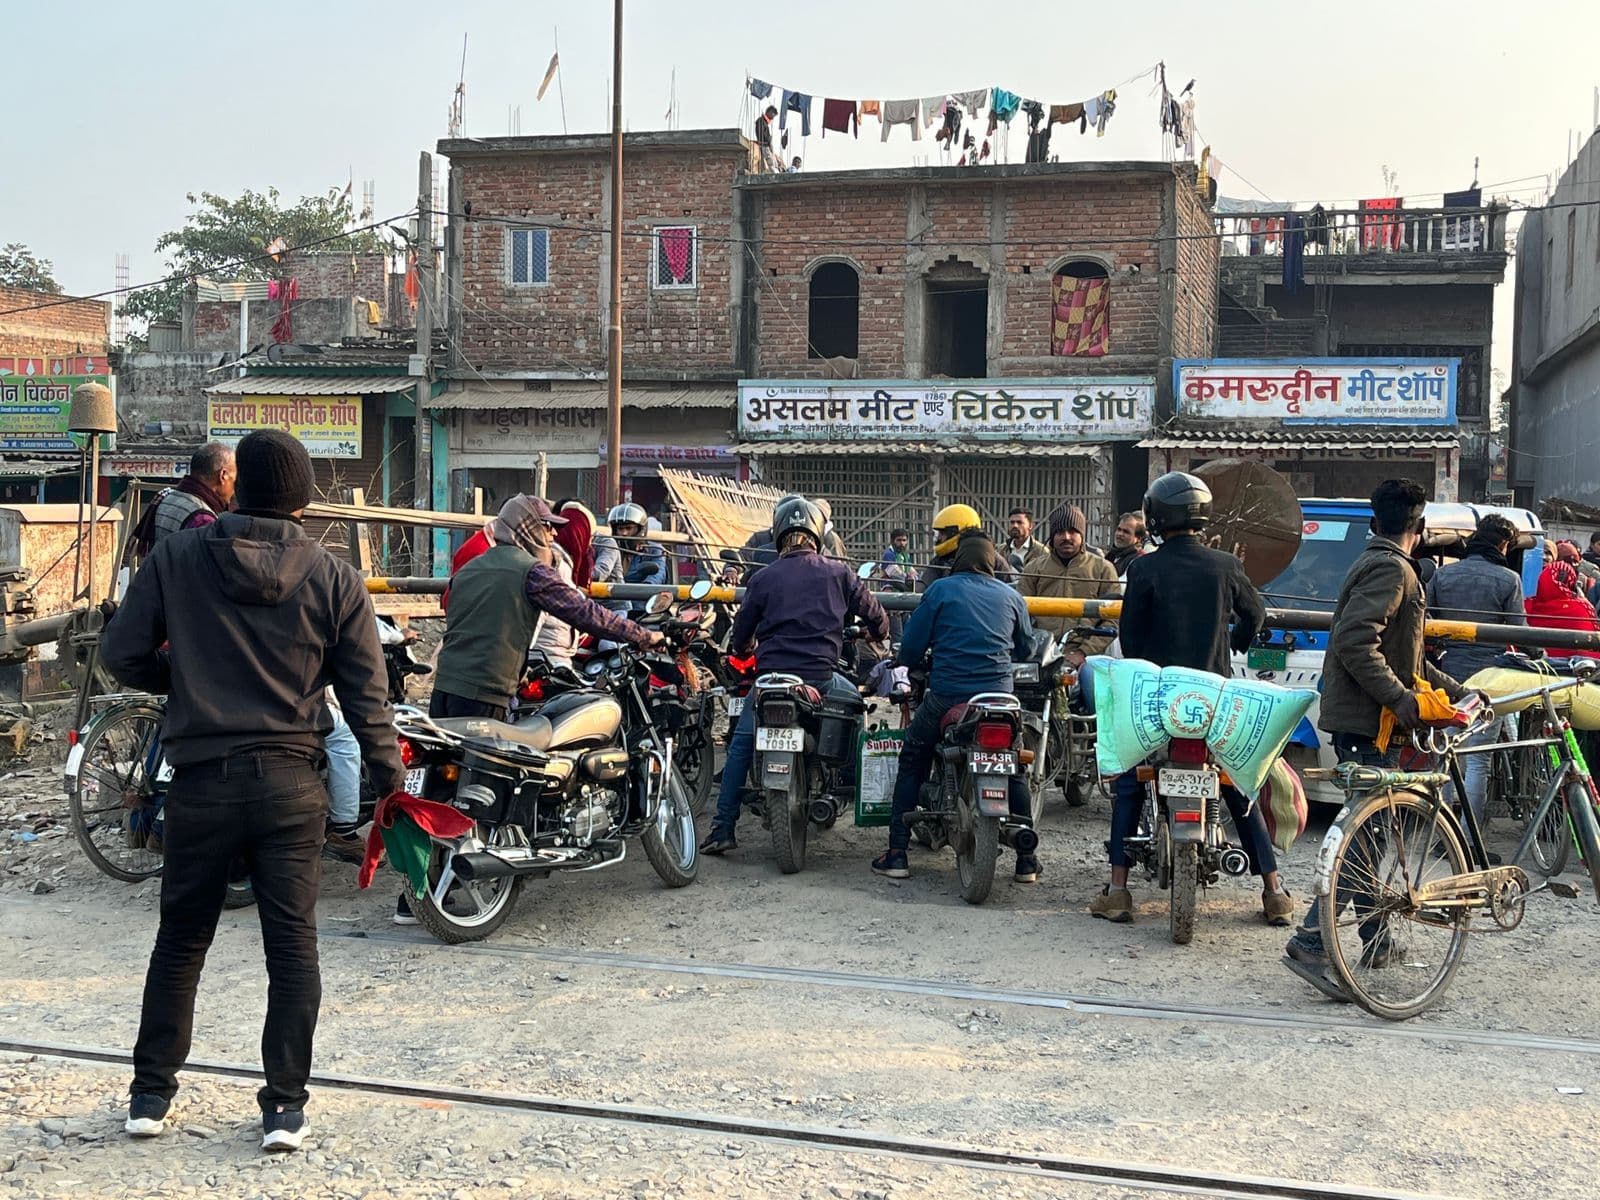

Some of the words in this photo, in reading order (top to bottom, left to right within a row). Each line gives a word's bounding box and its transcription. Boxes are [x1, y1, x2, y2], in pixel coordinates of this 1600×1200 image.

[23, 378, 70, 402] चिकेन
[1348, 369, 1395, 401] मीट
[1397, 372, 1445, 401] शॉप
[746, 398, 852, 421] असलम
[857, 390, 918, 421] मीट
[923, 402, 944, 416] एण्ड
[948, 390, 1063, 420] चिकेन
[1071, 391, 1139, 420] शॉप
[212, 403, 257, 424] बलराम
[330, 400, 358, 426] शॉप
[767, 730, 793, 739] BR43
[766, 741, 798, 750] Y0915
[973, 752, 1012, 762] BR-43R
[969, 762, 1016, 774] 1741
[1167, 783, 1210, 796] 7226
